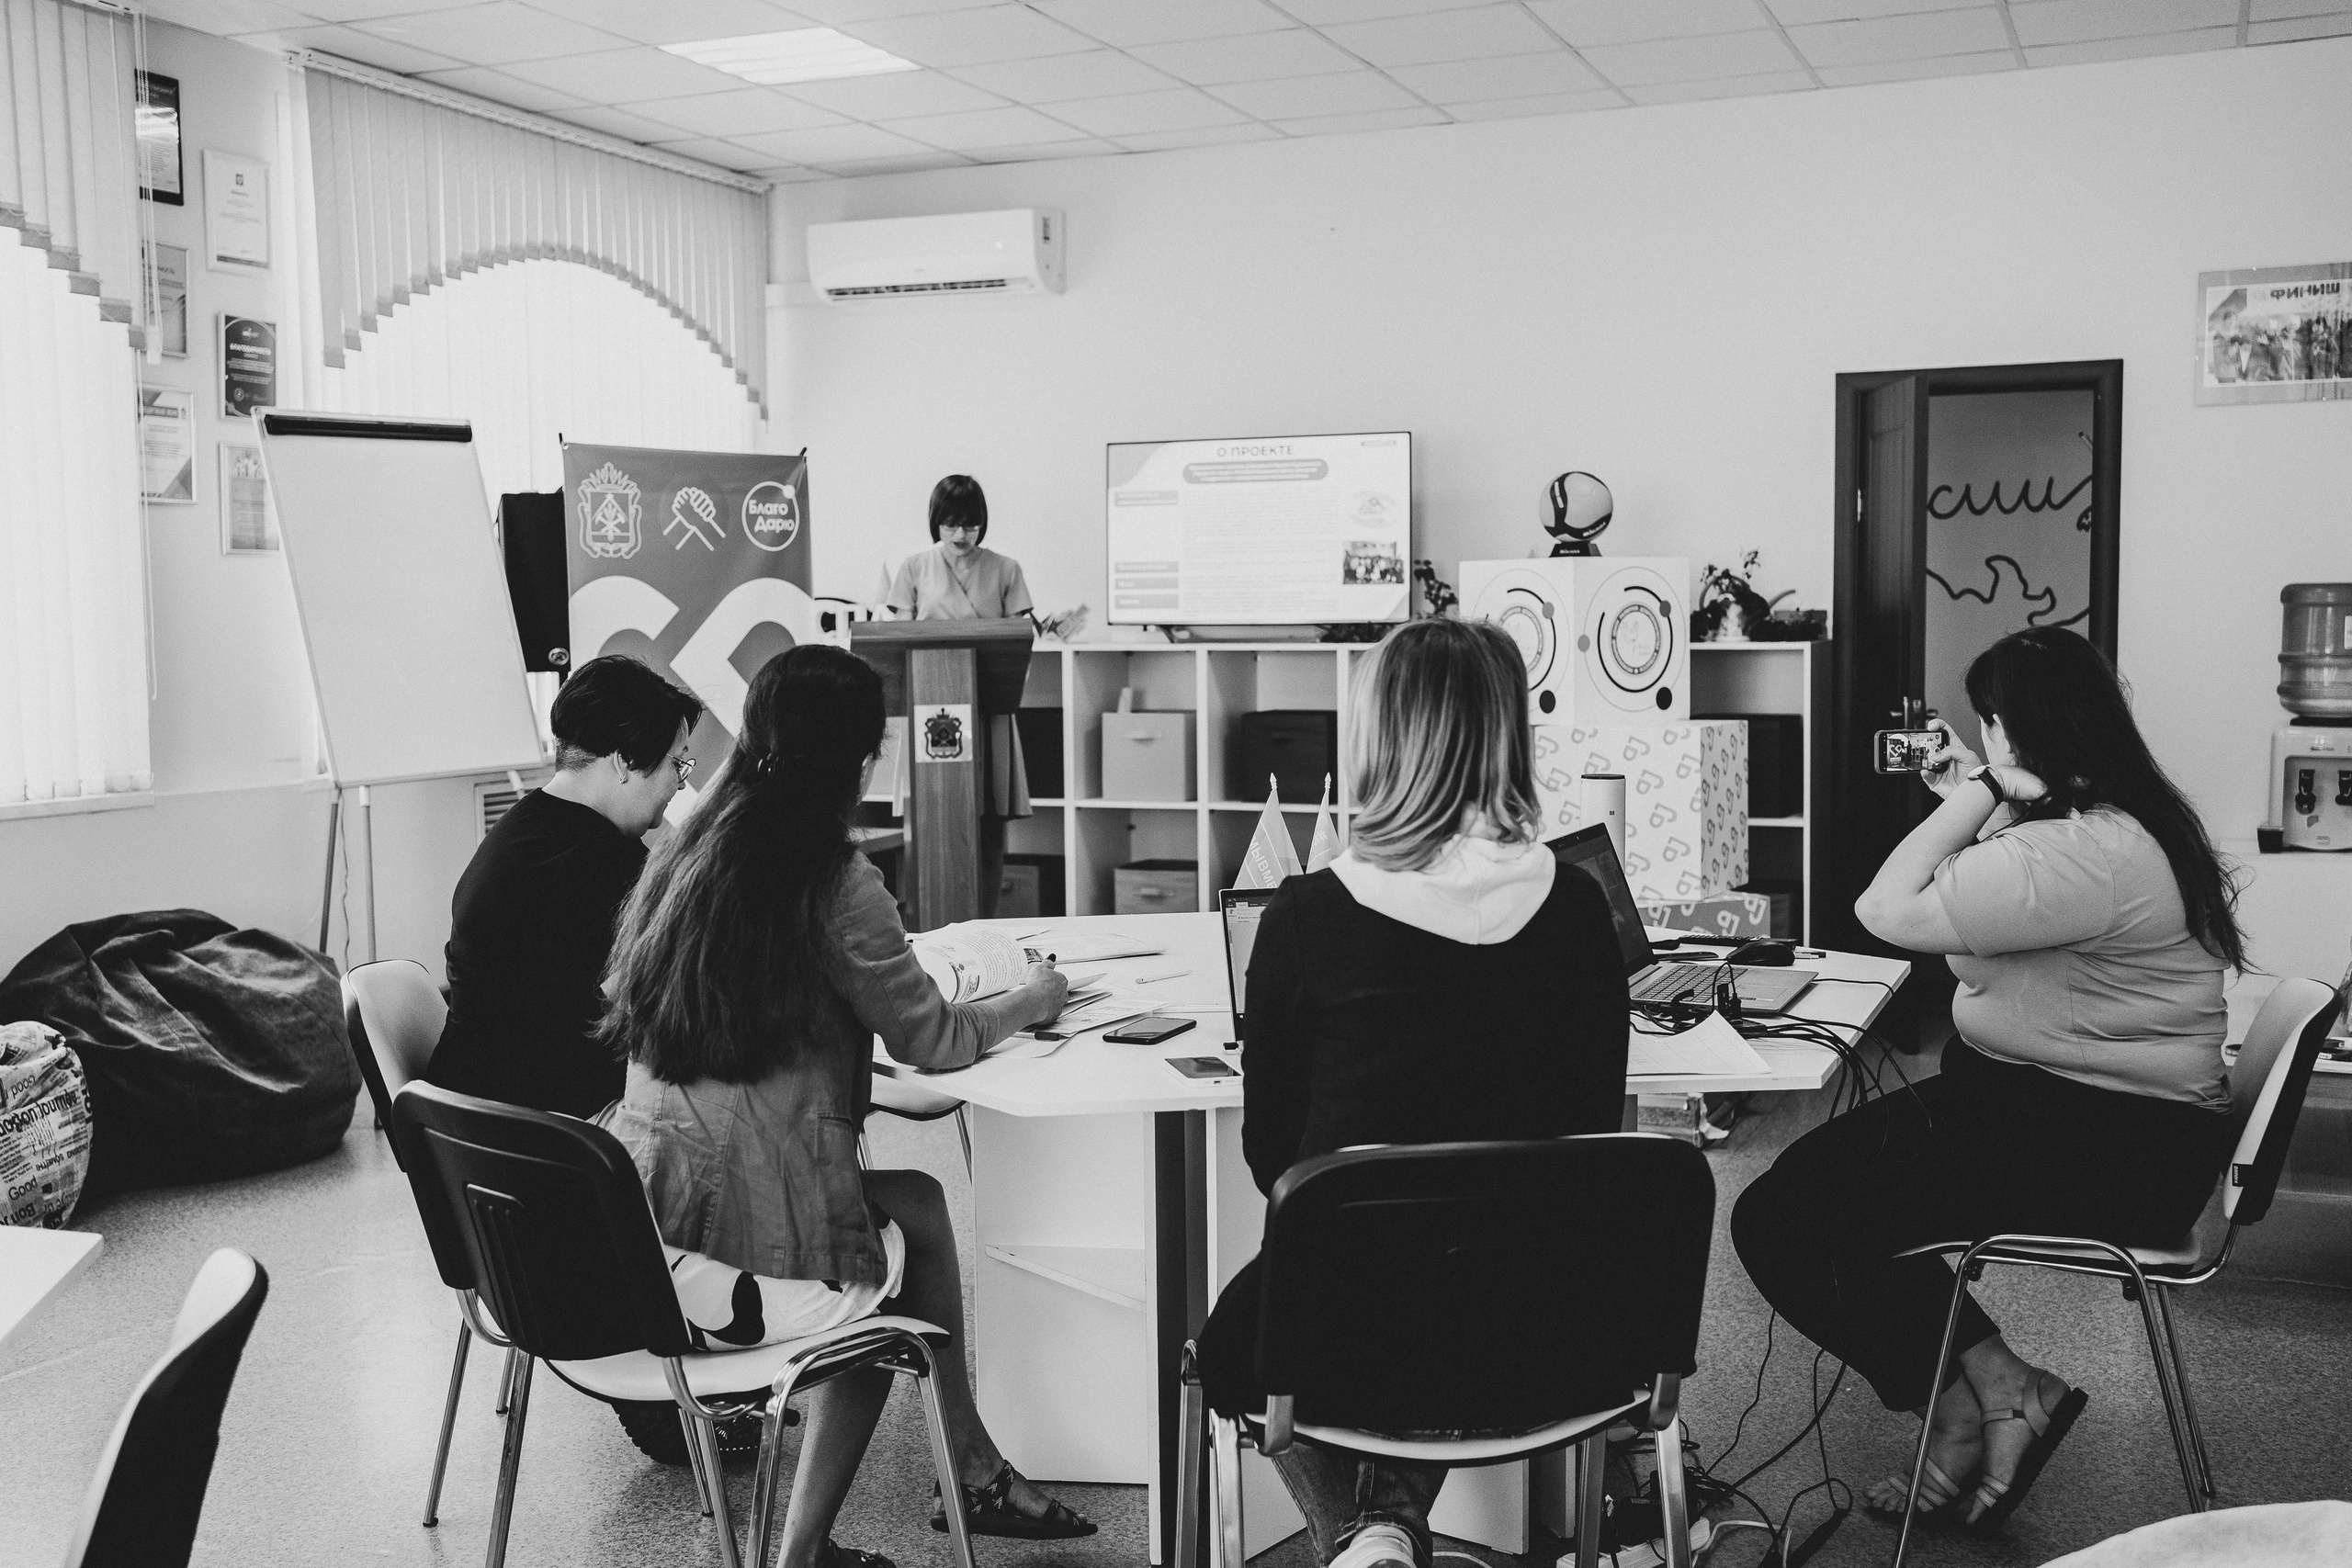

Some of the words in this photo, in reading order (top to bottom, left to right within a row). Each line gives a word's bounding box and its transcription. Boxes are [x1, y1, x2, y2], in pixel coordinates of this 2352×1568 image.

[2269, 282, 2341, 300] ФИНИШ
[1216, 447, 1227, 457] О
[1231, 445, 1294, 457] ПРОЕКТЕ
[748, 499, 789, 516] Благо
[754, 514, 795, 534] Дарю
[8, 1175, 38, 1201] Good
